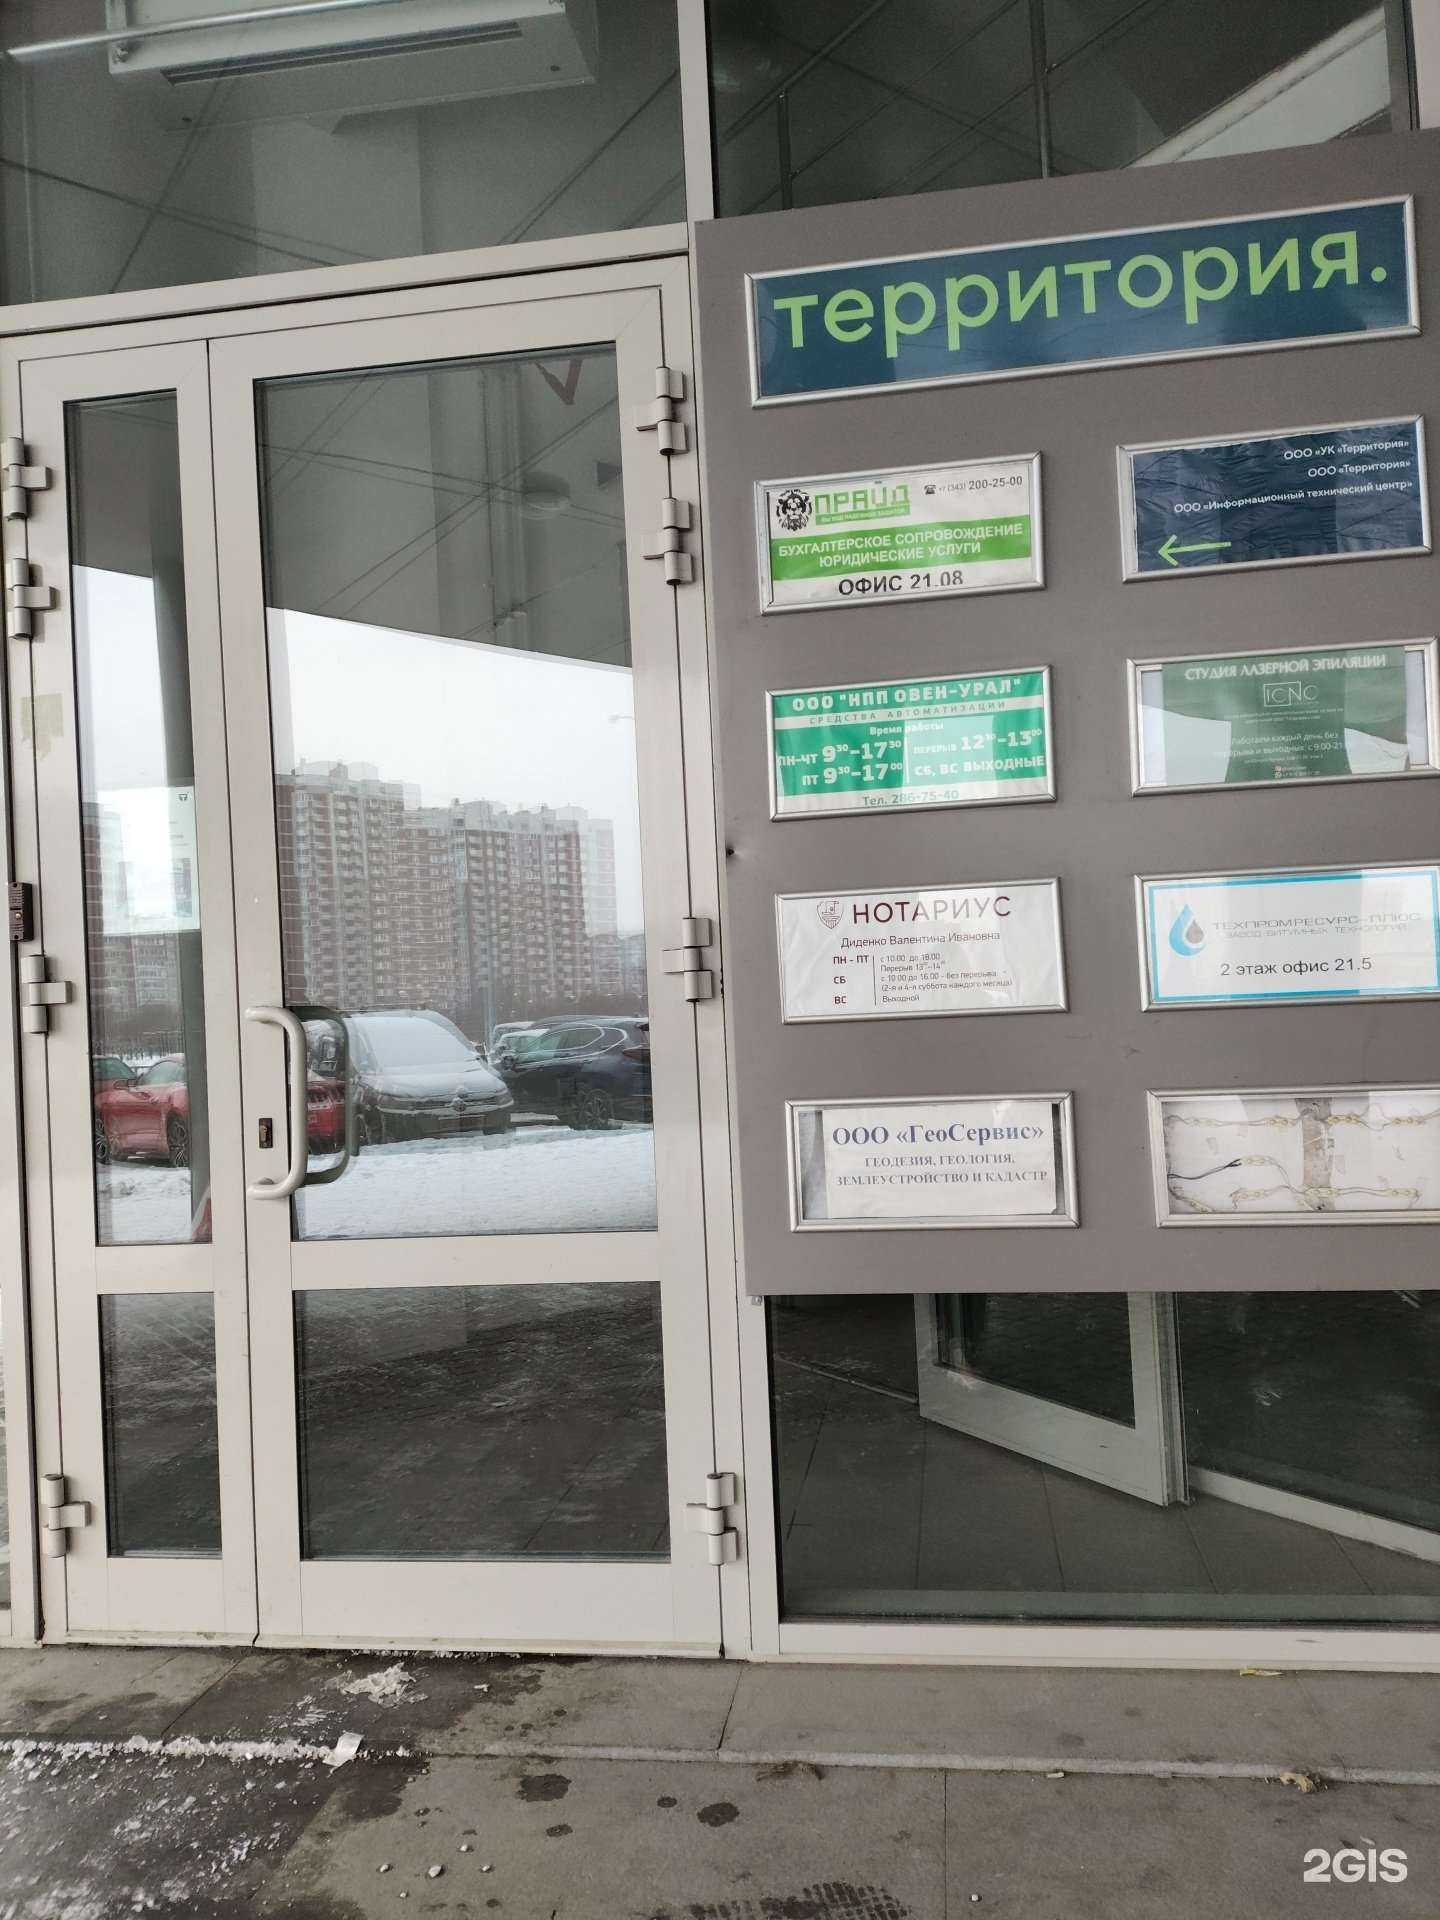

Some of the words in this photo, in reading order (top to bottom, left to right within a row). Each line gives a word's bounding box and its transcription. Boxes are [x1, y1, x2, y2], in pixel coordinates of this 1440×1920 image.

[774, 230, 1388, 359] территория.
[1283, 447, 1313, 460] ООО
[1315, 445, 1336, 457] «УК
[1337, 439, 1410, 455] «Территория»
[1307, 465, 1337, 478] ООО
[1338, 459, 1412, 475] «Территория»
[968, 475, 1023, 491] 200-25-00
[814, 480, 911, 514] ПРАЙД
[1173, 502, 1202, 514] ООО
[1203, 489, 1306, 511] «Информационный
[1306, 483, 1375, 499] технический
[1375, 479, 1413, 493] центр»
[778, 535, 893, 558] БУХГАЛТЕРСКОЕ
[894, 523, 1024, 545] СОПРОВОЖДЕНИЕ
[819, 547, 926, 569] ЮРИДИЧЕСКИЕ
[929, 541, 982, 557] УСЛУГИ
[837, 574, 903, 597] ОФИС
[909, 569, 964, 591] 21.08
[1183, 664, 1238, 681] СТУДИЯ
[1239, 657, 1310, 678] ЛАЗЕРНОЙ
[1311, 654, 1386, 671] ЭПИЛЯЦИИ
[791, 697, 834, 712] ООО
[839, 690, 889, 707] "НПП
[894, 677, 1022, 703] ОВЕН-УРАЛ"
[809, 712, 877, 725] СРЕДСТВА
[886, 701, 1007, 719] АВТОМАТИЗАЦИИ
[869, 725, 903, 737] Время
[903, 720, 944, 734] работы
[777, 753, 818, 769] ПН-ЧТ
[914, 763, 937, 779] СБ,
[939, 762, 959, 776] ВС
[962, 755, 1046, 773] ВЫХОДНЫЕ
[801, 774, 819, 787] ПТ
[863, 794, 889, 807] Тел.
[853, 895, 1012, 925] НОТАРИУС
[840, 935, 888, 949] Диденко
[889, 933, 946, 946] Валентина
[948, 930, 1001, 944] Ивановна
[832, 955, 847, 965] ПН
[856, 954, 870, 964] ПТ
[1219, 963, 1231, 976] 2
[1235, 963, 1278, 975] этаж
[1281, 959, 1330, 976] офис
[1334, 956, 1373, 972] 21.5
[832, 975, 847, 984] СБ
[834, 995, 847, 1005] ВС
[832, 1125, 890, 1146] ООО
[896, 1122, 1045, 1146] «ГеоСервис»
[864, 1154, 937, 1168] ГЕОДЕЗИЯ,
[835, 1172, 969, 1186] ЗЕМЛЕУСТРОЙСТВО
[971, 1173, 983, 1183] И
[984, 1170, 1048, 1183] КАДАСТР
